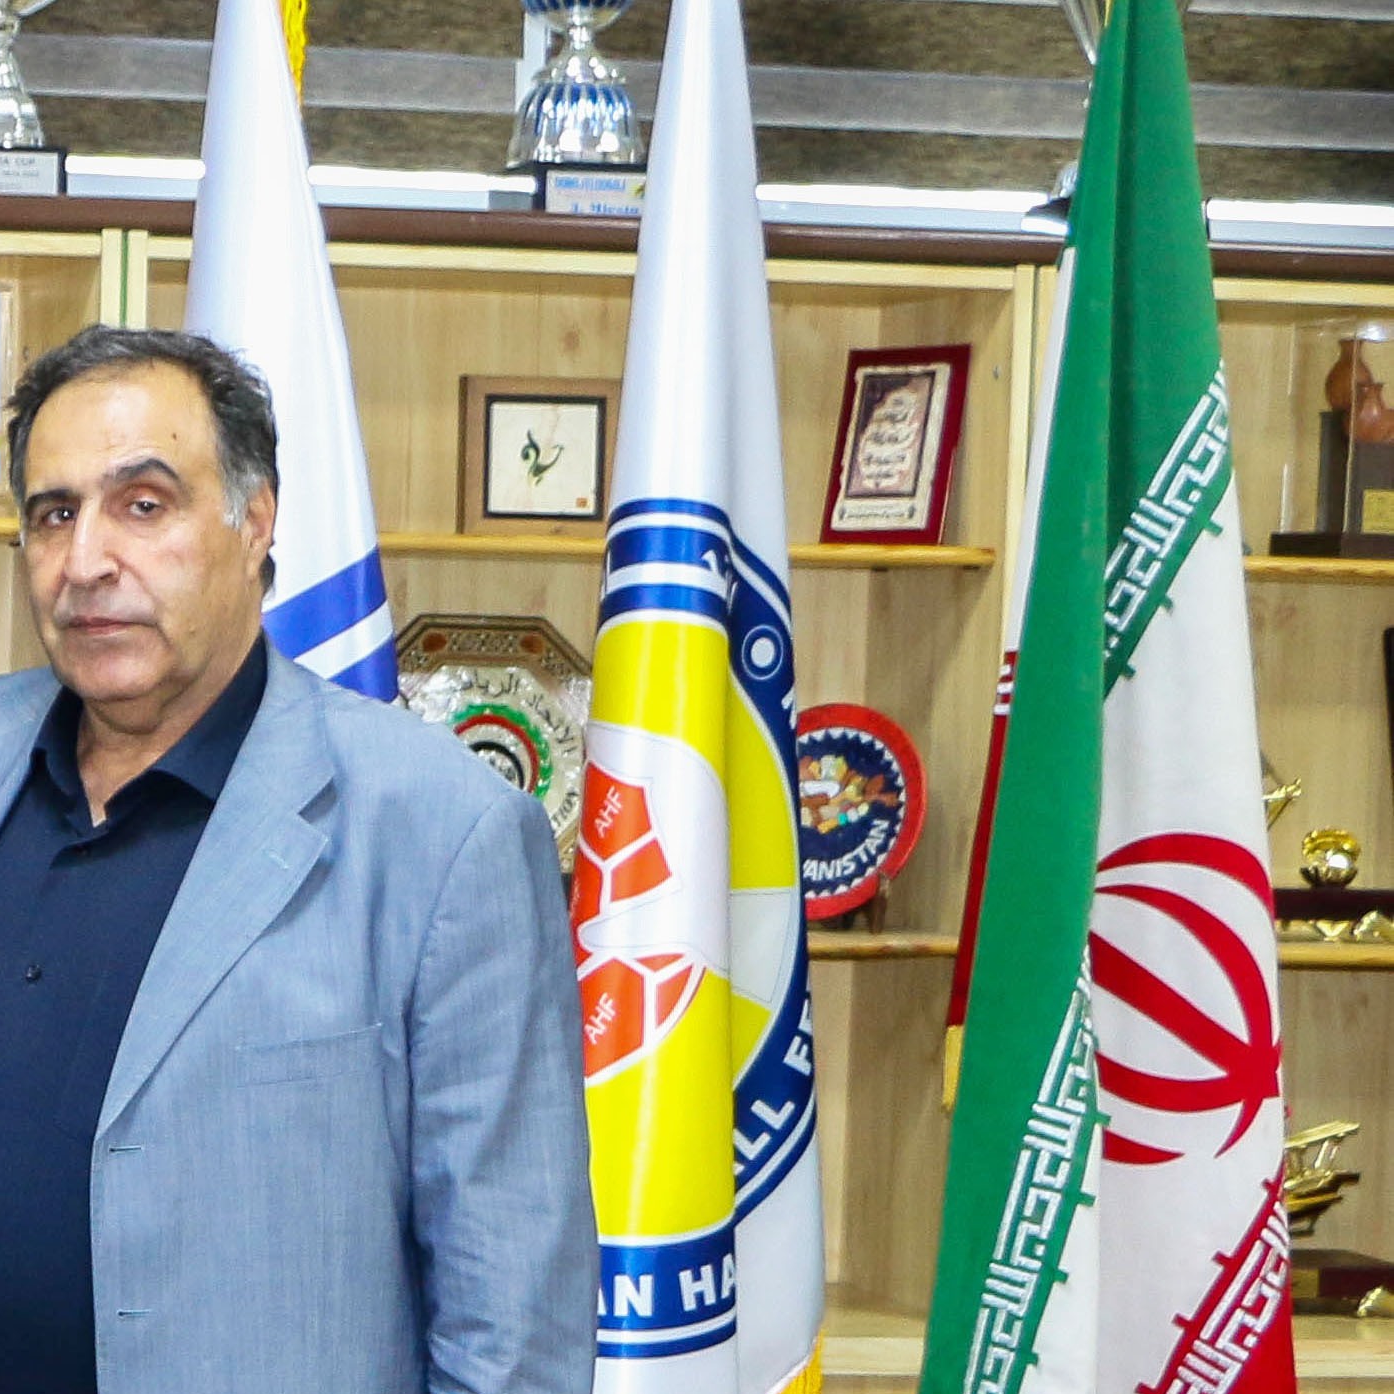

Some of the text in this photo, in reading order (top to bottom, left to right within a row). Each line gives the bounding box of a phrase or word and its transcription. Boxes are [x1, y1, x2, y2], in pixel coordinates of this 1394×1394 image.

[593, 786, 624, 838] AHF
[803, 818, 891, 881] ANISTAN
[583, 992, 617, 1045] AHF
